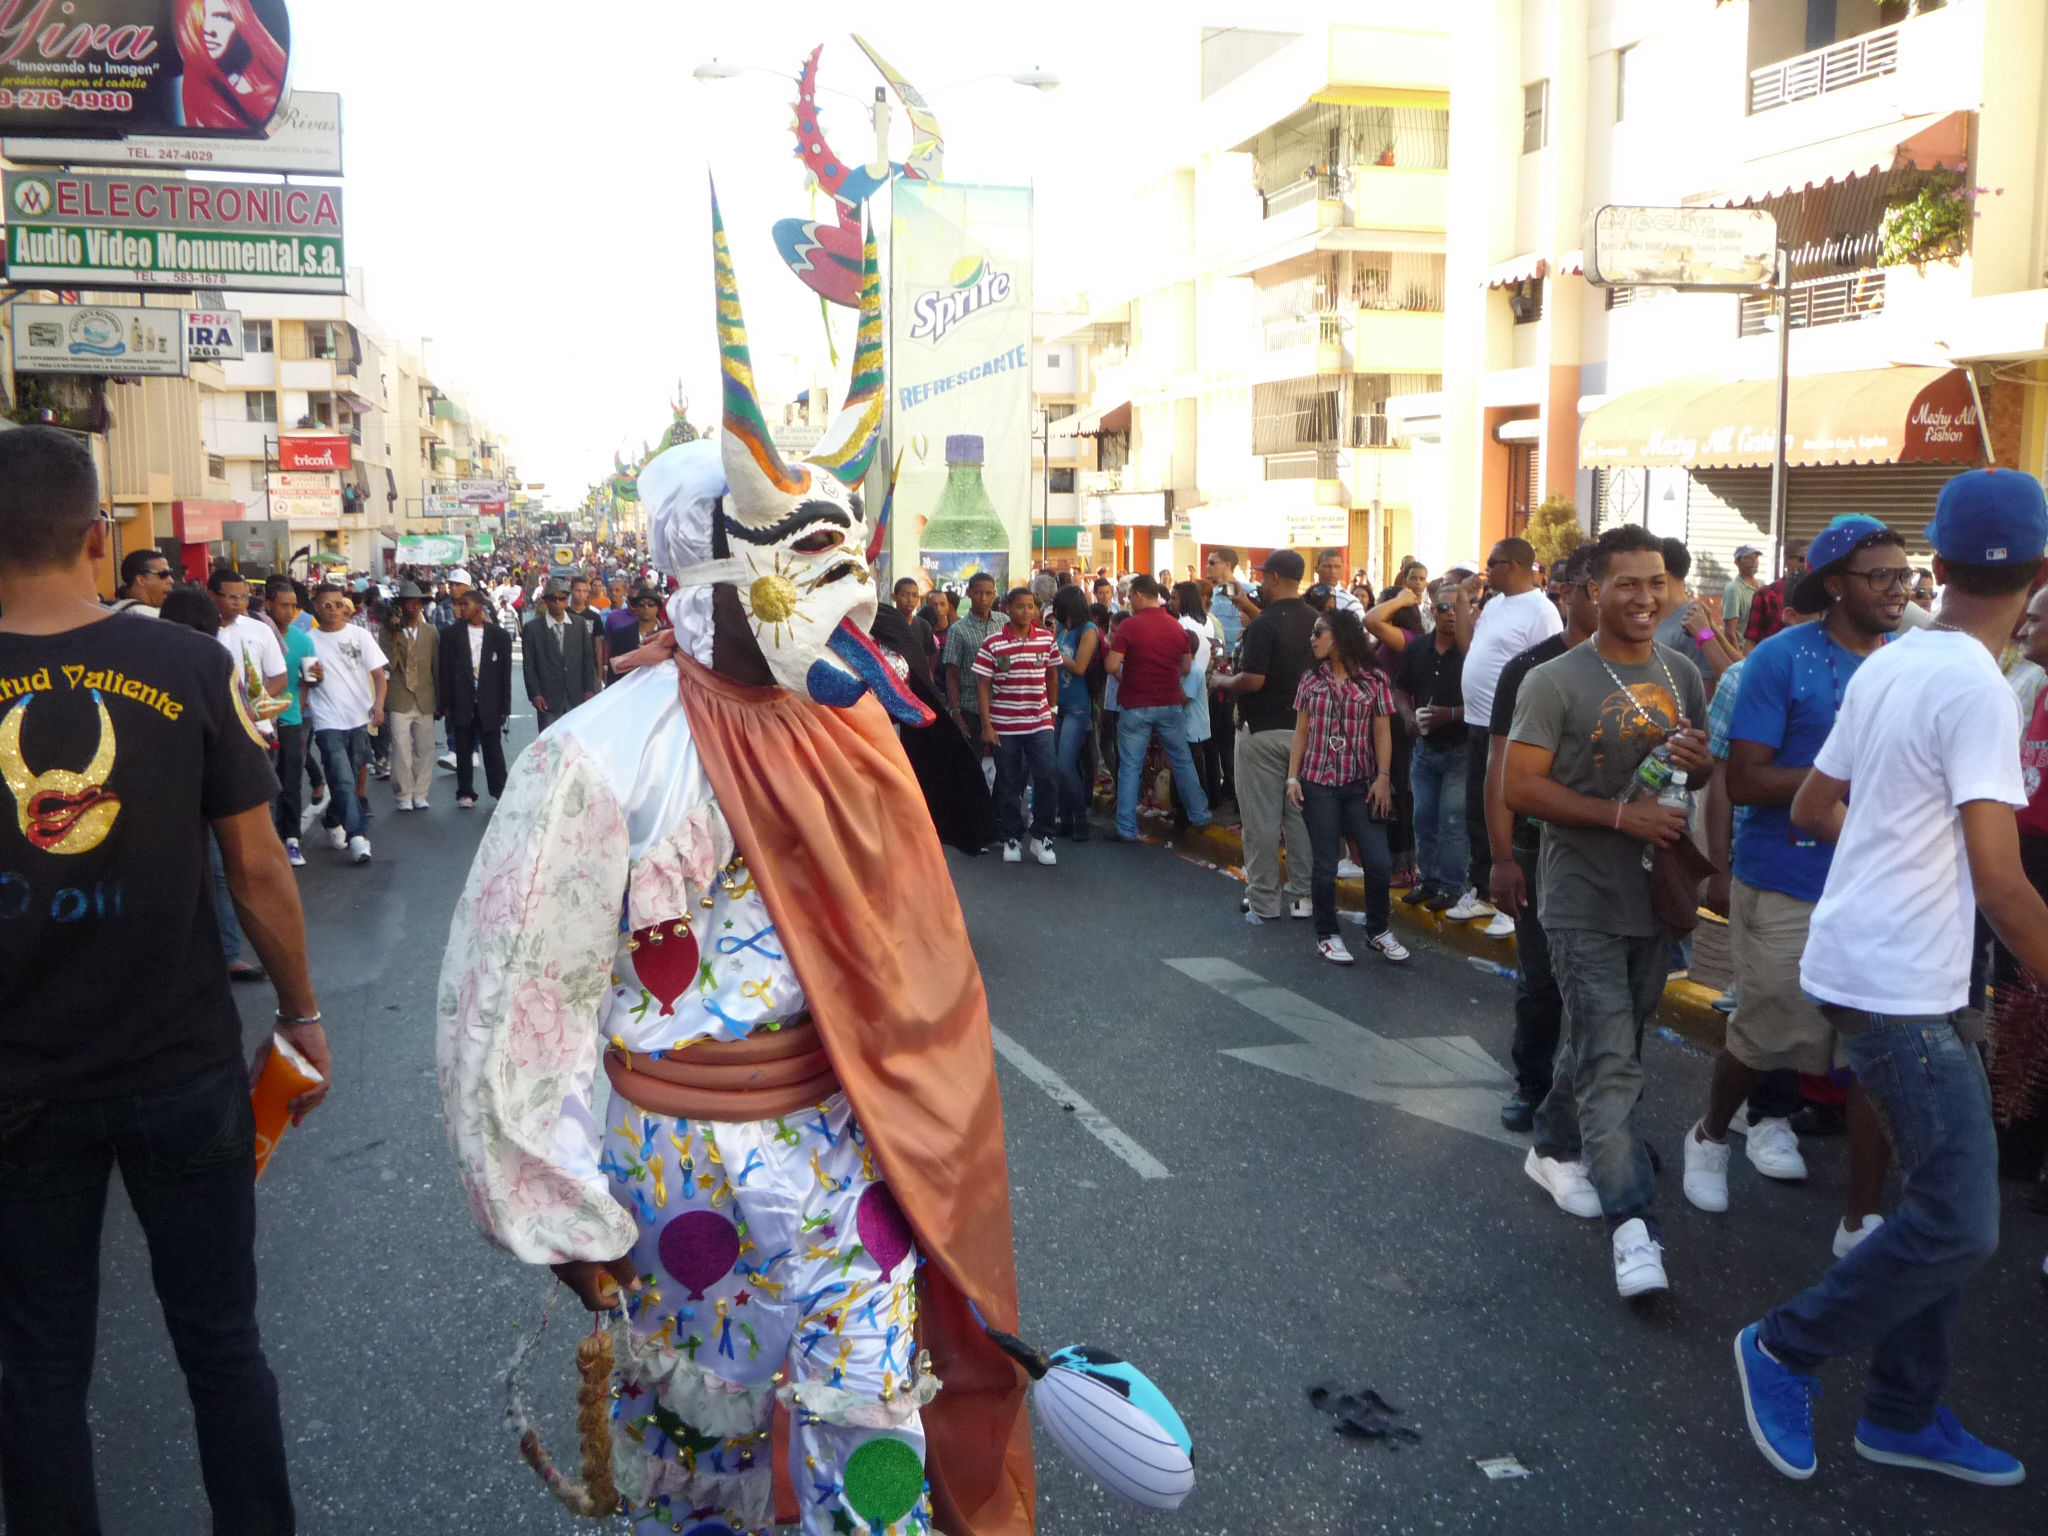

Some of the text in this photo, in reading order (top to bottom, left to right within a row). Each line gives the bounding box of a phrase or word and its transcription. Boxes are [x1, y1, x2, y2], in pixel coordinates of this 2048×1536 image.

[88, 62, 102, 74] tu
[105, 61, 160, 77] Imagen"
[60, 78, 90, 88] para
[93, 77, 102, 87] el
[106, 78, 148, 88] cabello
[284, 108, 335, 131] Rivas
[127, 148, 213, 161] TEL. 247-4029
[56, 181, 339, 226] ELECTRONICA
[16, 226, 81, 265] Audio
[85, 230, 151, 268] Video
[173, 272, 227, 284] 583-1678
[910, 262, 1010, 344] Sprite
[899, 343, 1028, 412] REFRESCANTE
[1911, 402, 1977, 430] Mechy All
[294, 453, 334, 467] tricom
[0, 664, 184, 722] tud Valiente
